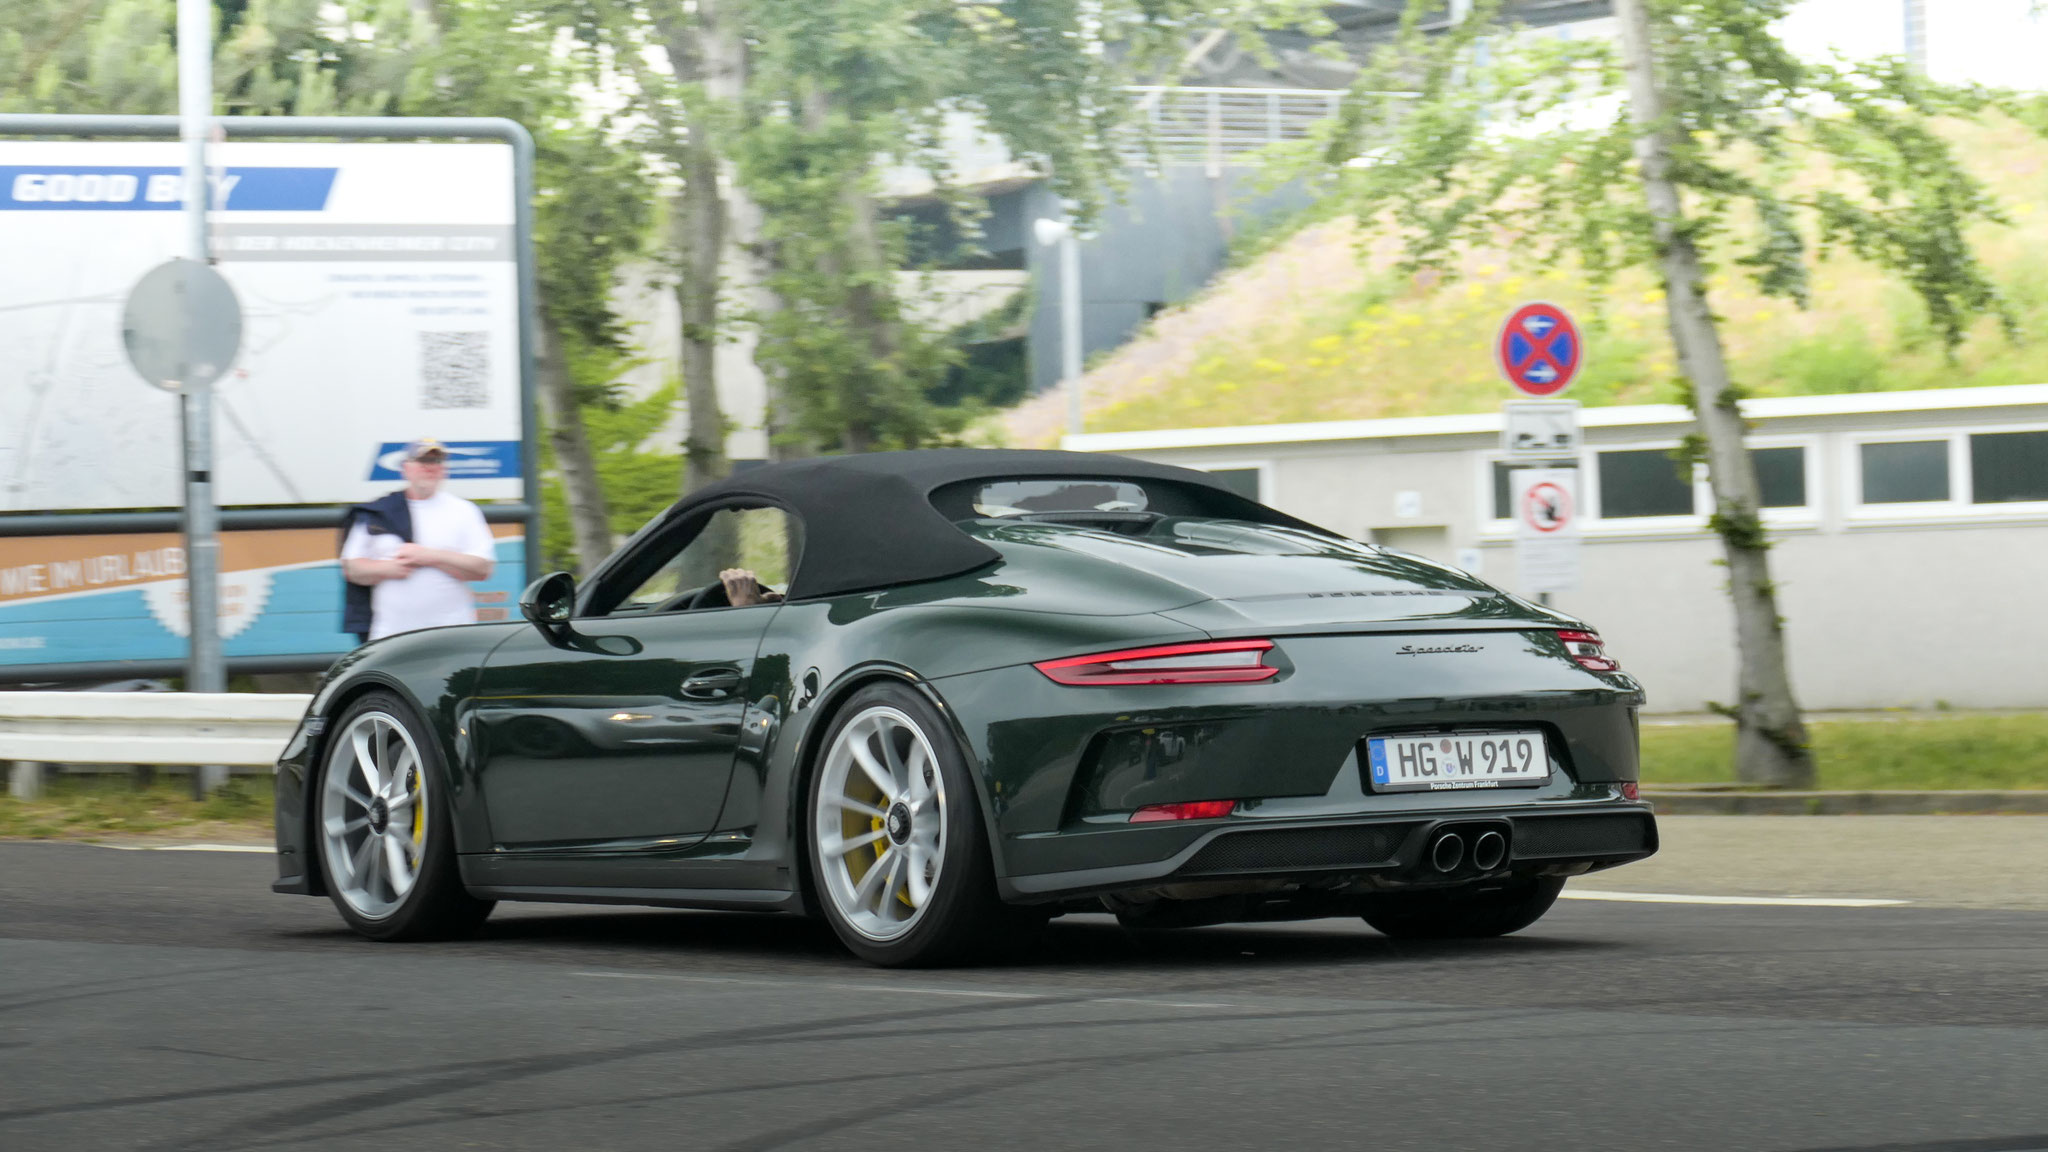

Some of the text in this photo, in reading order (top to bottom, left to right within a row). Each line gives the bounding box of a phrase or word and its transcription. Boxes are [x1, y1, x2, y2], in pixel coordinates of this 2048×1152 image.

[11, 174, 241, 203] GOOD BY
[83, 547, 188, 584] URLAUB
[1396, 642, 1484, 657] Speedster
[1398, 739, 1533, 777] HG W 919
[1376, 766, 1385, 777] D
[1430, 780, 1499, 790] Porsche Zentrum Frankfurt
